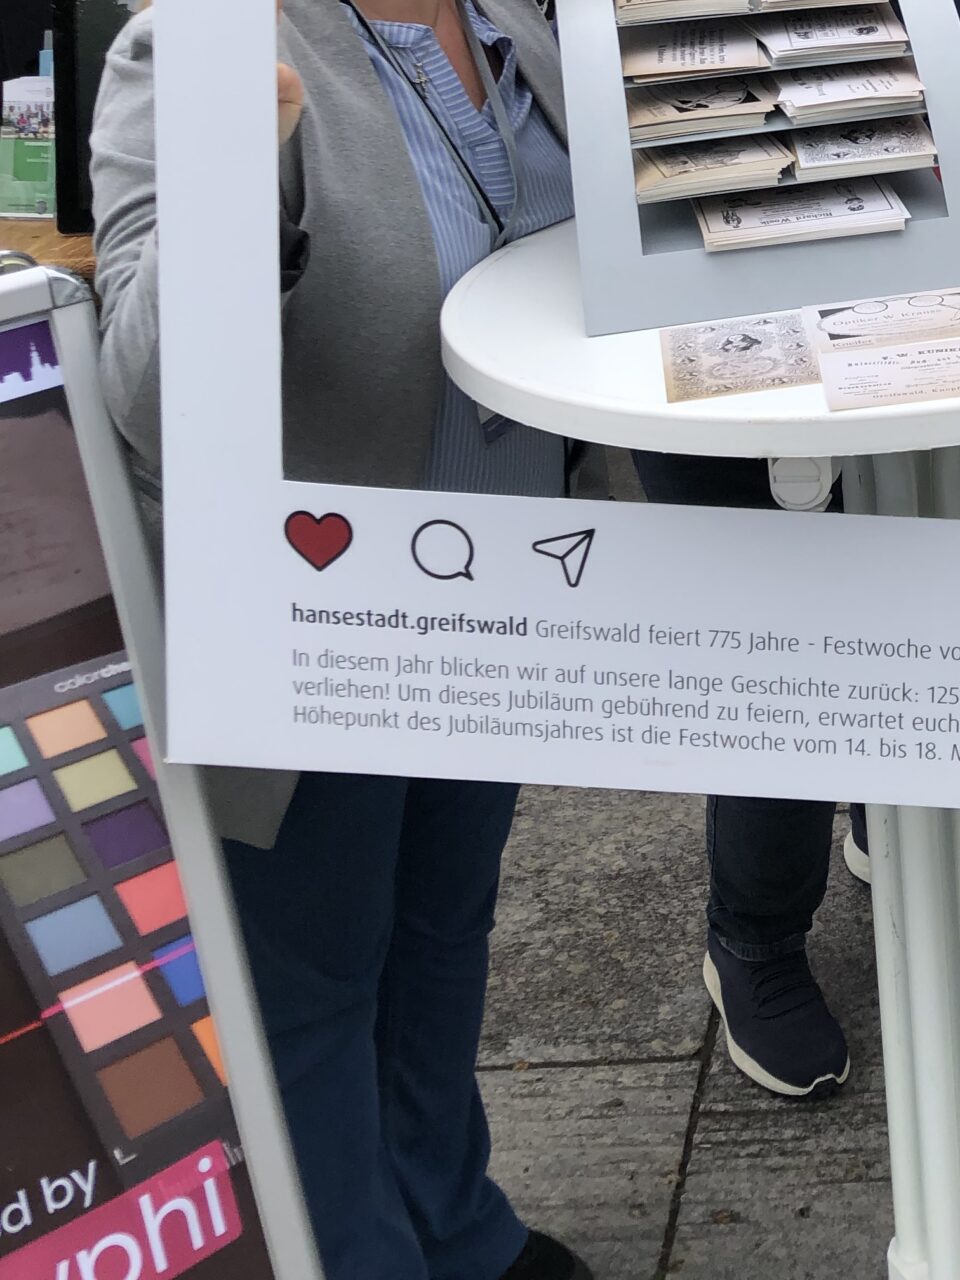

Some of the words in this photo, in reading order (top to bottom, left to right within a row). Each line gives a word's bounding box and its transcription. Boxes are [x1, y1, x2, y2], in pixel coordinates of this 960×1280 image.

[290, 601, 529, 638] hansestadt.greifswald
[535, 619, 641, 644] Greifswald
[647, 623, 702, 648] feiert
[707, 629, 742, 650] 775
[746, 630, 800, 655] Jahre
[823, 635, 932, 660] Festwoche
[292, 648, 310, 668] In
[316, 648, 390, 673] diesem
[393, 653, 435, 678] Jahr
[440, 655, 510, 680] blicken
[515, 662, 549, 682] wir
[554, 664, 587, 685] auf
[593, 670, 661, 689] unsere
[668, 668, 724, 697] lange
[730, 674, 841, 699] Geschichte
[847, 681, 919, 703] zurück:
[291, 676, 391, 701] verliehen!
[397, 682, 432, 703] Um
[437, 683, 502, 708] dieses
[505, 688, 594, 713] Jubiläum
[600, 694, 709, 720] gebührend
[716, 705, 739, 722] zu
[745, 701, 810, 729] feiern,
[817, 711, 905, 731] erwartet
[911, 712, 960, 734] euch
[292, 704, 401, 731] Höhepunkt
[406, 709, 442, 732] des
[445, 713, 605, 744] Jubiläumsjahres
[611, 723, 635, 744] ist
[640, 723, 672, 746] die
[678, 727, 786, 752] Festwoche
[792, 737, 837, 756] vom
[843, 737, 872, 757] 14.
[879, 736, 908, 759] bis
[914, 741, 943, 761] 18.
[40, 1158, 97, 1214] by
